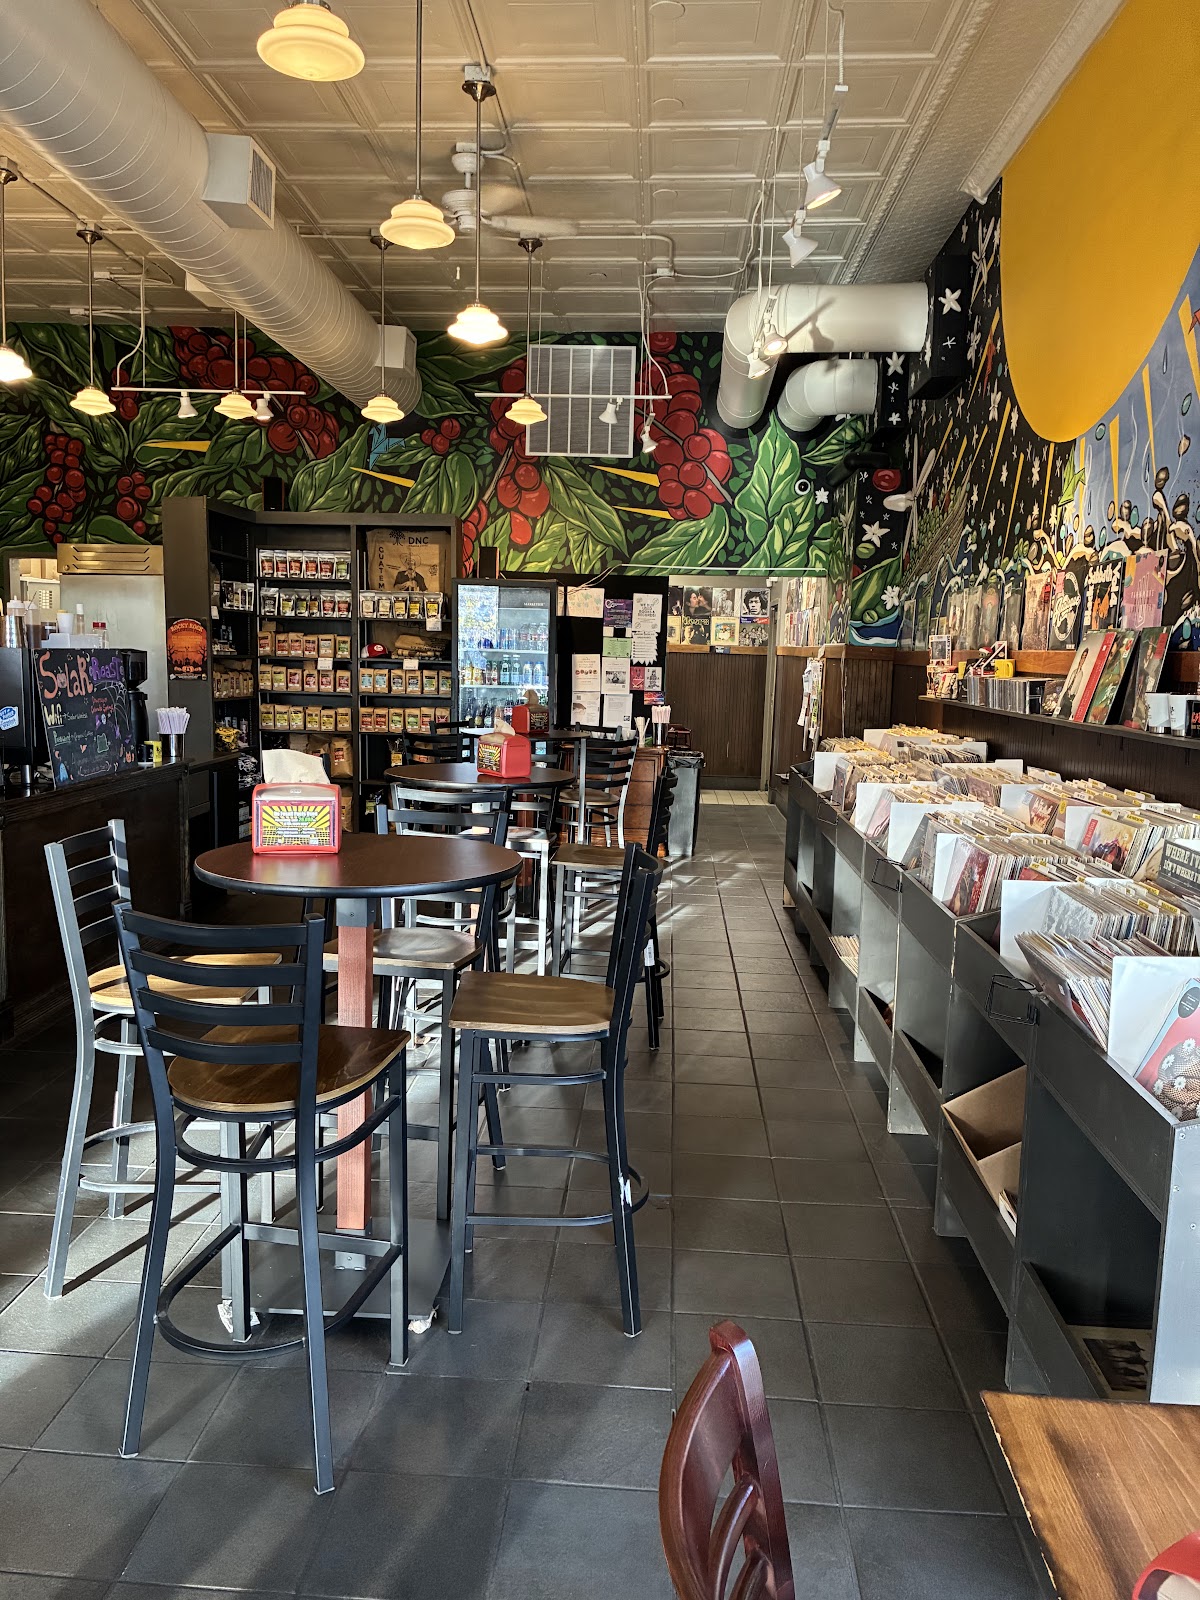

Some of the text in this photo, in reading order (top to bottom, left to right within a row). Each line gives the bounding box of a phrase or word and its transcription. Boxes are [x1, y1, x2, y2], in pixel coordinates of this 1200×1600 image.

[408, 536, 429, 545] DNC
[378, 546, 386, 591] GUATEM
[1166, 844, 1189, 865] WHERE
